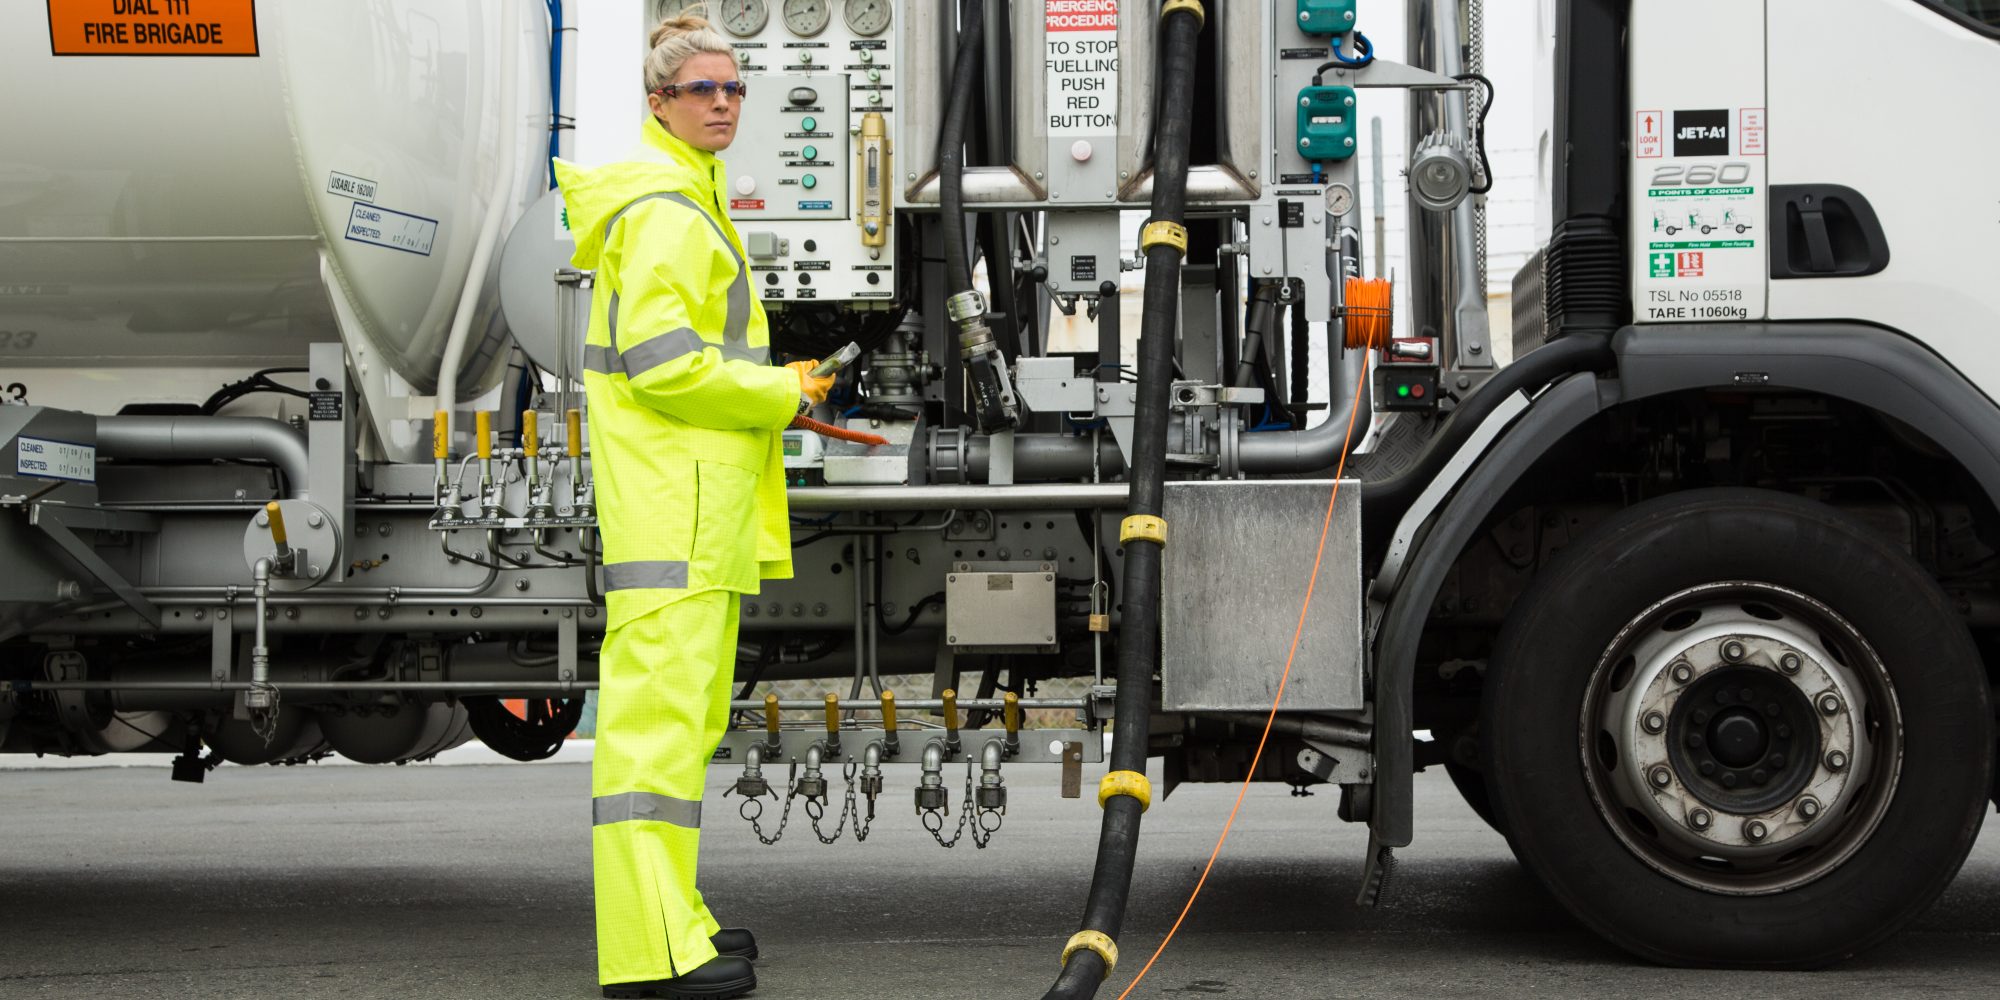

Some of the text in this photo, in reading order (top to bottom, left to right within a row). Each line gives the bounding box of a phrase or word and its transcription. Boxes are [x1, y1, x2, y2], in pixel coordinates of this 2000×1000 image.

[113, 0, 190, 15] DIAL 111
[84, 23, 223, 44] FIRE BRIGADE
[1048, 40, 1118, 54] TO STOP
[1062, 78, 1105, 91] PUSH
[1067, 96, 1099, 109] RED
[1050, 114, 1118, 127] BUTTON
[1677, 126, 1725, 140] JET-A1
[1640, 136, 1658, 144] LOOK
[1651, 163, 1750, 186] 260
[331, 177, 374, 198] USABLE 16200
[1708, 187, 1751, 195] CONTACT
[350, 225, 381, 239] INSPECTED:
[1648, 290, 1742, 302] TSL No 05518
[1648, 306, 1747, 319] TARE 11060kg
[21, 442, 43, 453] CLEANED:
[20, 459, 47, 471] INSPECTED:
